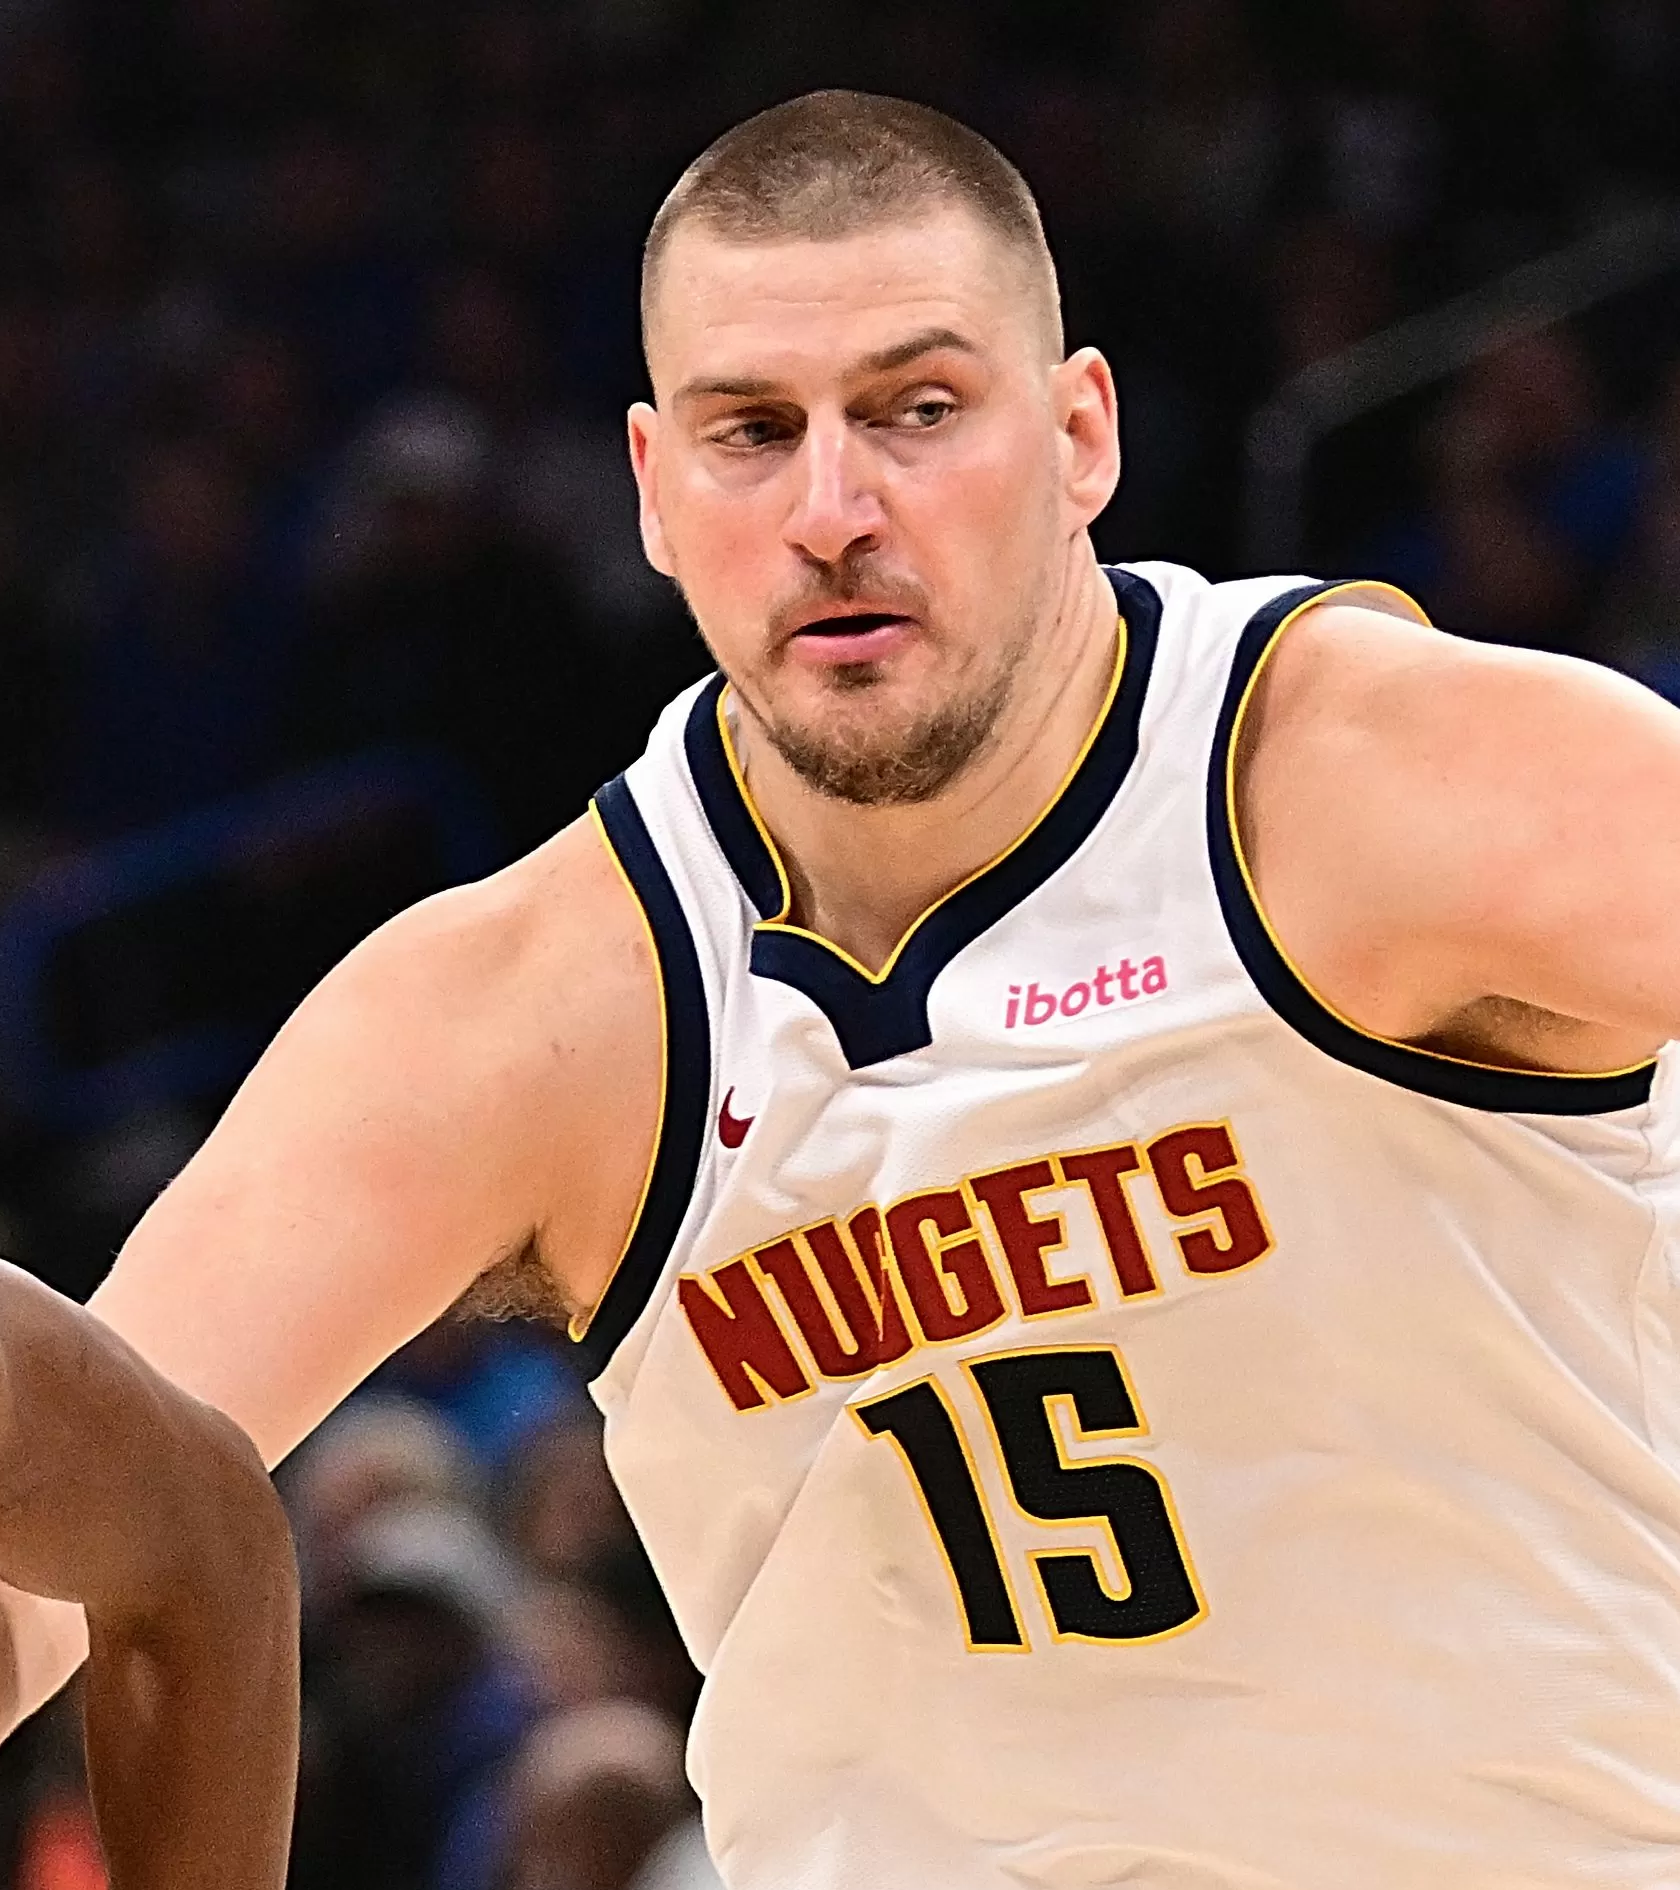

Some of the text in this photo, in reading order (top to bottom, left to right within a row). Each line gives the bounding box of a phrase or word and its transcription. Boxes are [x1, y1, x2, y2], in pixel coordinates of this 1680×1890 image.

[1004, 955, 1169, 1029] ibotta
[677, 1116, 1276, 1415] NUGETS
[846, 1342, 1211, 1654] 15
